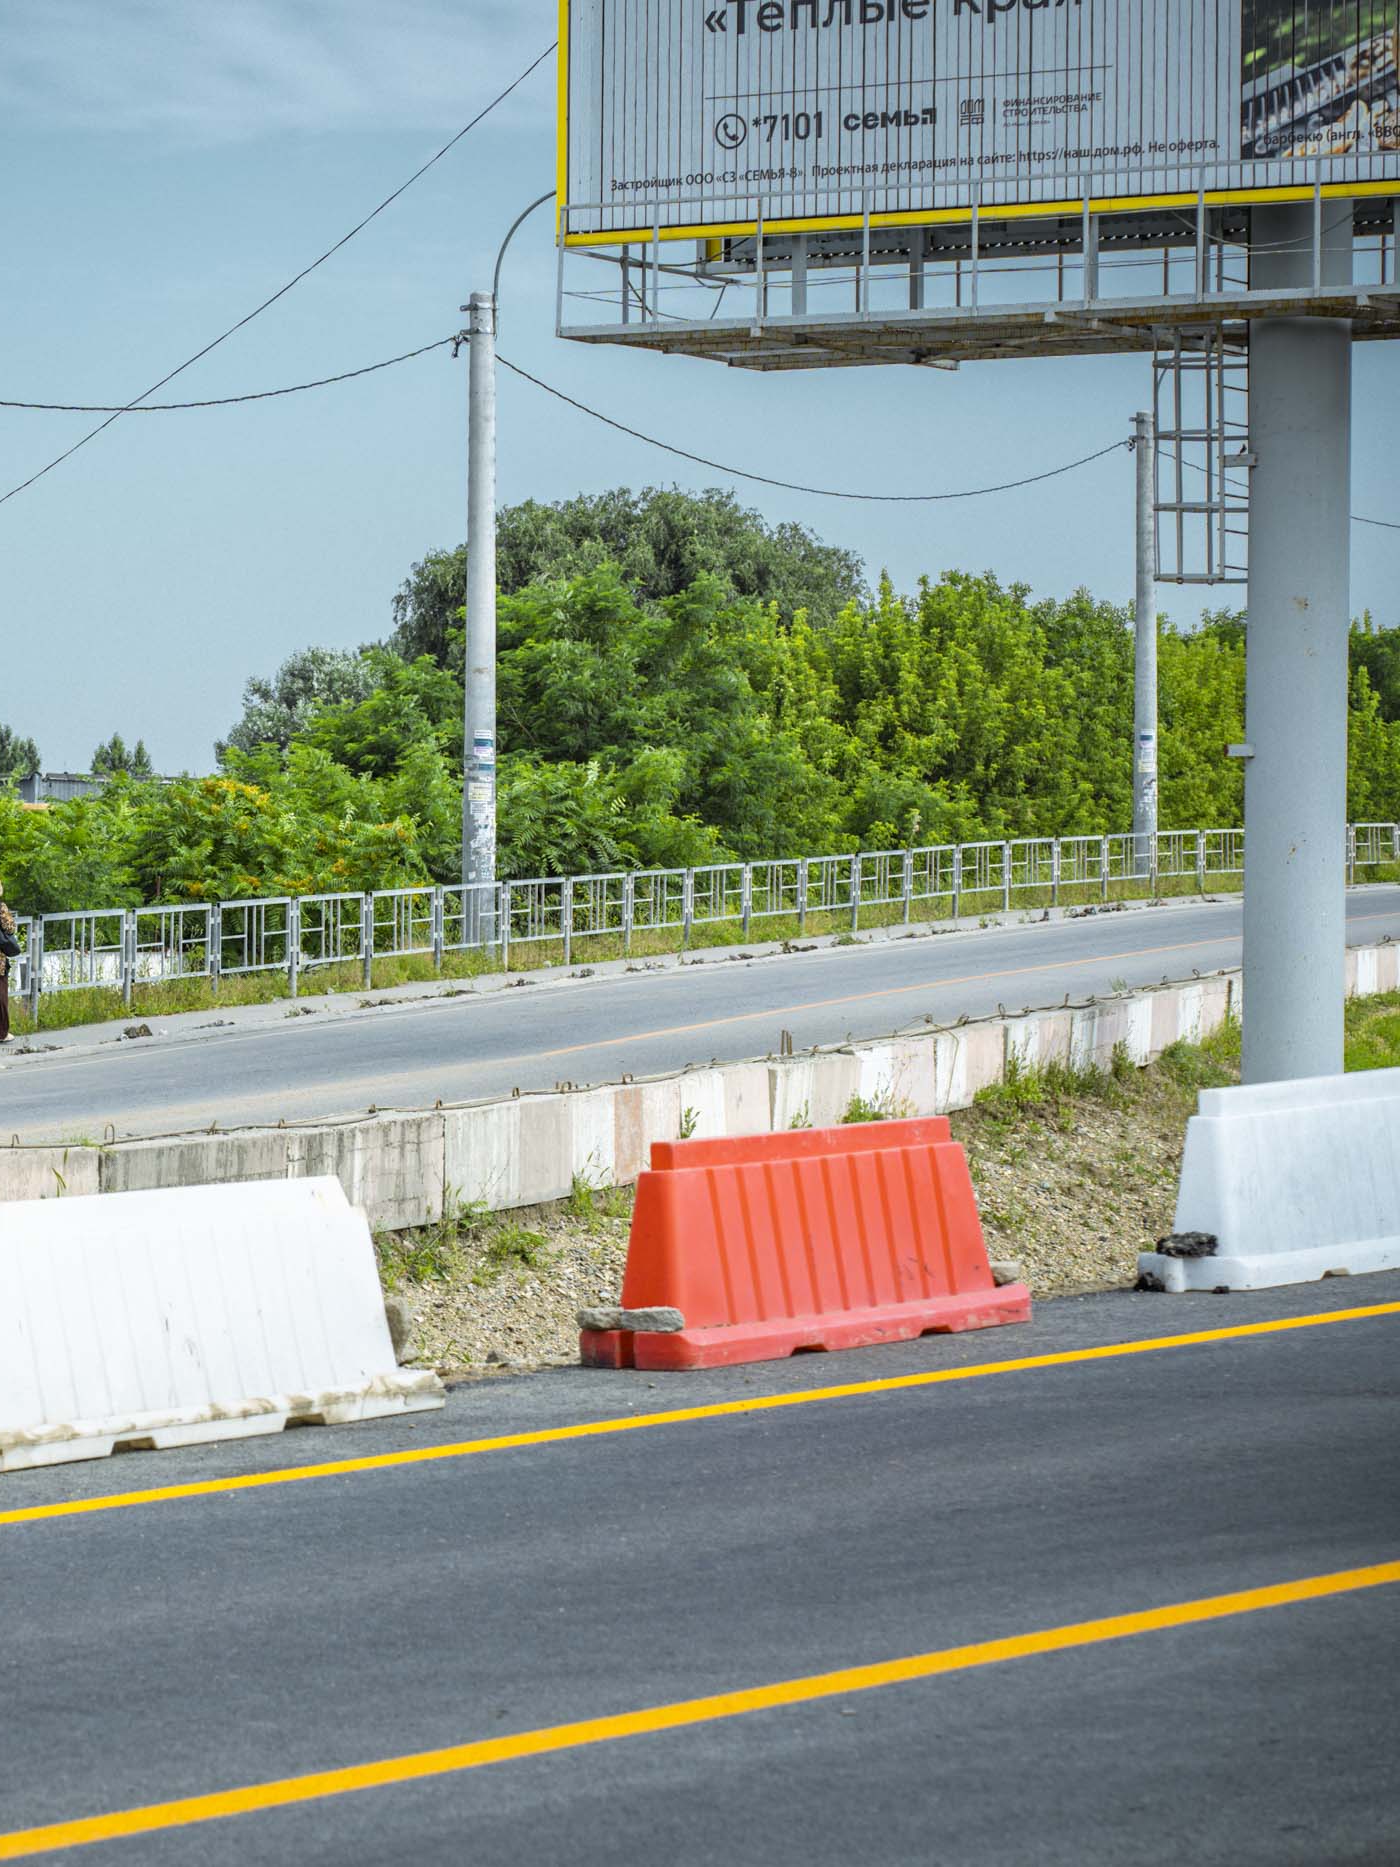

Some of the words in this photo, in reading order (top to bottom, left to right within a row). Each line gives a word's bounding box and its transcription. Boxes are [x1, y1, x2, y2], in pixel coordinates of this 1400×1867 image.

[705, 0, 930, 34] «Теплые
[1002, 92, 1103, 108] ФИНАНСИРОВАНИЕ
[1002, 103, 1088, 118] СТРОИТЕЛЬСТВА
[1263, 131, 1323, 146] барбекю
[1326, 128, 1365, 143] (англ.
[610, 176, 683, 192] Застройщик
[685, 172, 714, 186] ООО
[716, 171, 736, 184] «СЗ
[812, 163, 879, 178] Проектная
[881, 157, 957, 174] декларация
[960, 155, 974, 167] на
[977, 152, 1016, 165] сайте:
[1149, 141, 1165, 153] Не
[1169, 138, 1220, 154] оферта.
